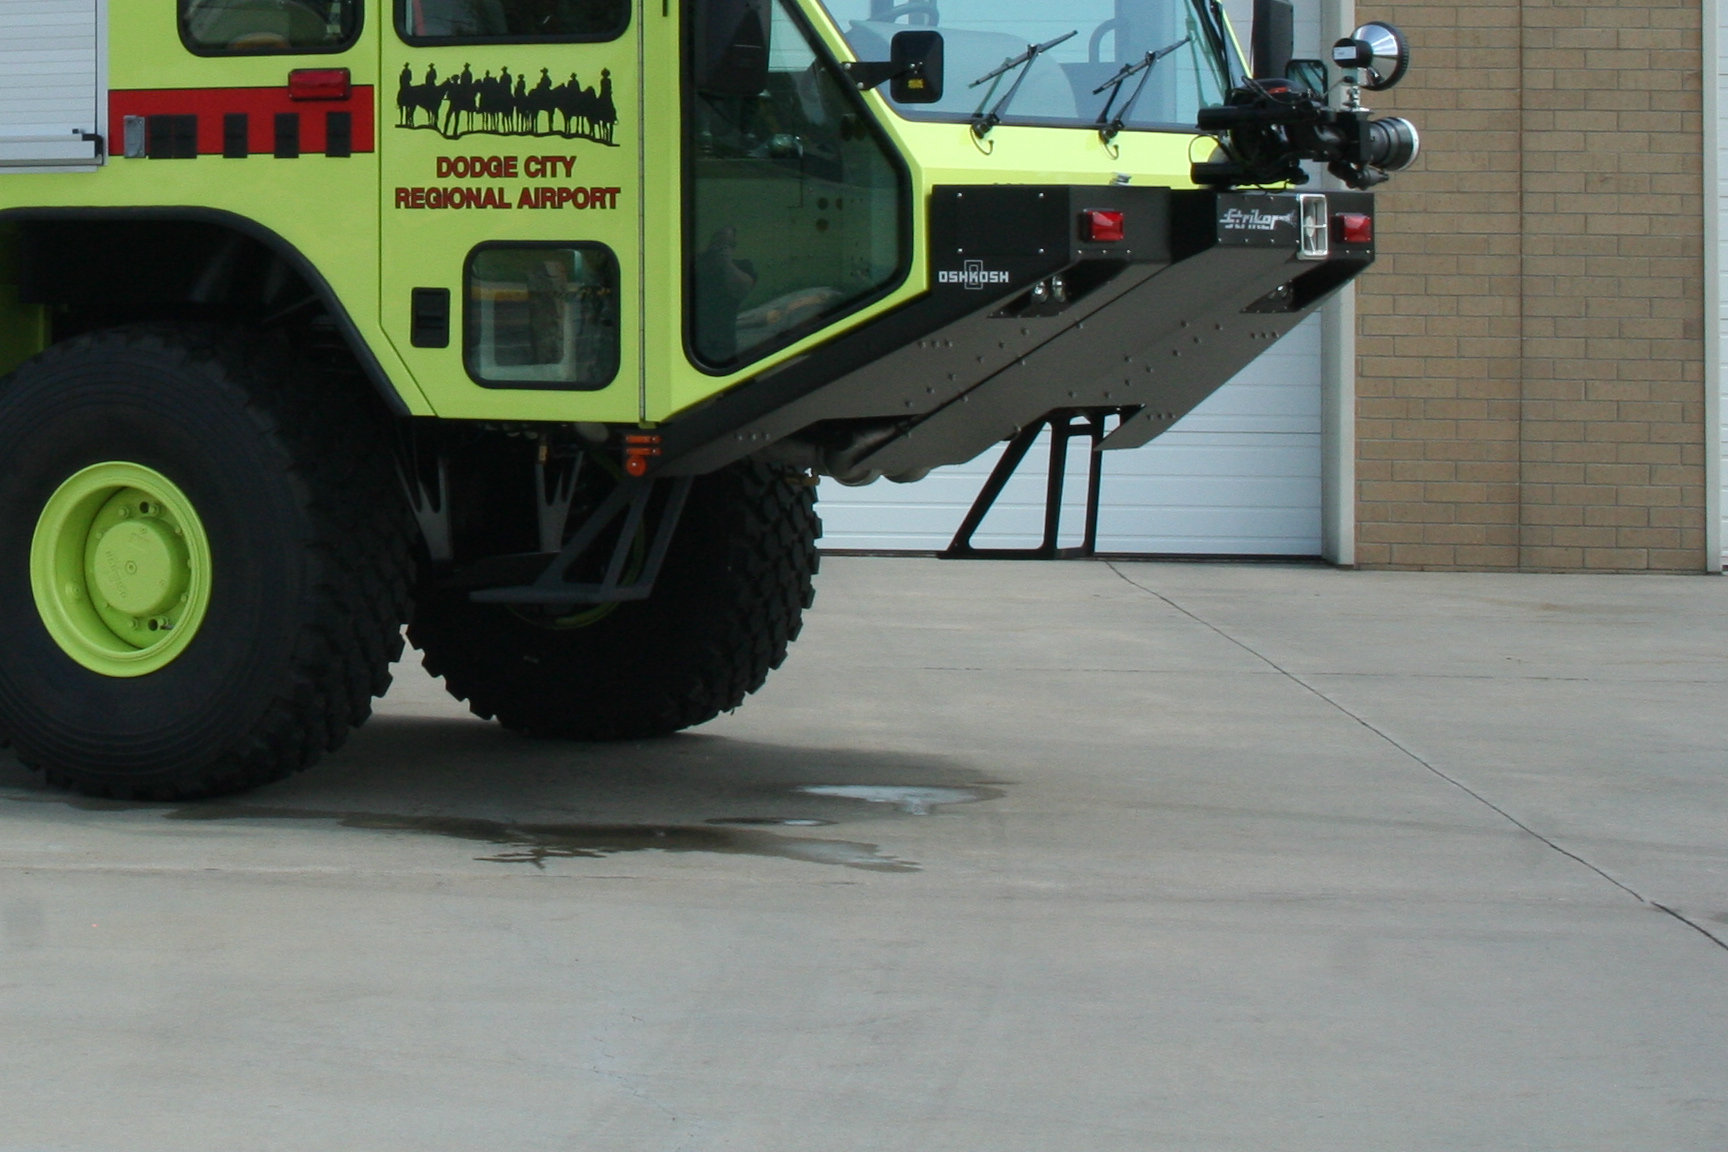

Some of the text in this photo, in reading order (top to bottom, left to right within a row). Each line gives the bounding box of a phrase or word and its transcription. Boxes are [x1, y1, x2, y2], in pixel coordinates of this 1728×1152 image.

[436, 155, 577, 178] DODGE CITY
[394, 186, 621, 209] REGIONAL AIRPORT
[938, 270, 1010, 283] OSHKOSH
